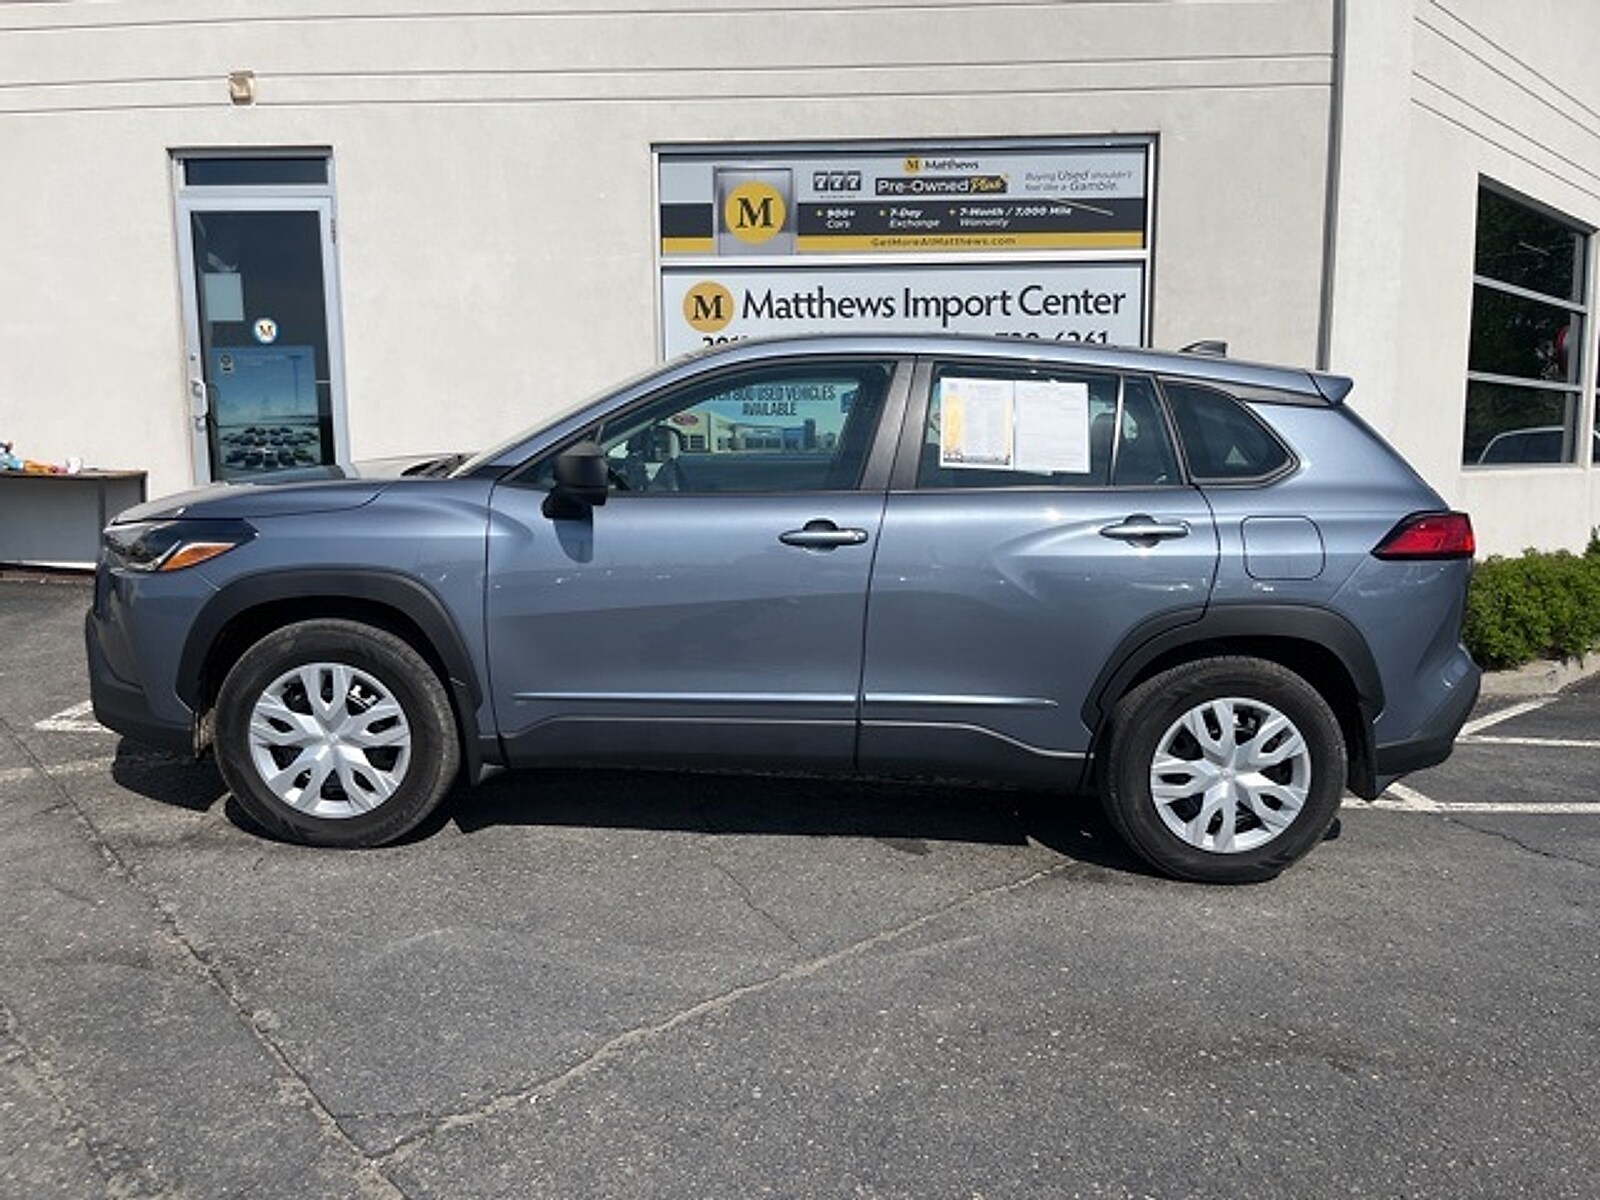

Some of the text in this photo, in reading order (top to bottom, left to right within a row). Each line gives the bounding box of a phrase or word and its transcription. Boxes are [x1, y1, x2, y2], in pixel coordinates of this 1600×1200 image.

[906, 157, 979, 170] M Matthews
[1058, 169, 1089, 181] Used
[878, 179, 969, 193] Pre-Owned
[735, 198, 773, 228] M
[890, 208, 923, 219] 7-Day
[960, 206, 1004, 217] 7-Month
[1050, 206, 1073, 216] Mile
[889, 218, 941, 229] Exchange
[960, 217, 1010, 229] Warranty
[692, 285, 1126, 328] M Matthews Import Center
[759, 386, 786, 400] USED
[787, 385, 836, 400] VEHICLES
[742, 402, 798, 416] AVAILABLE
